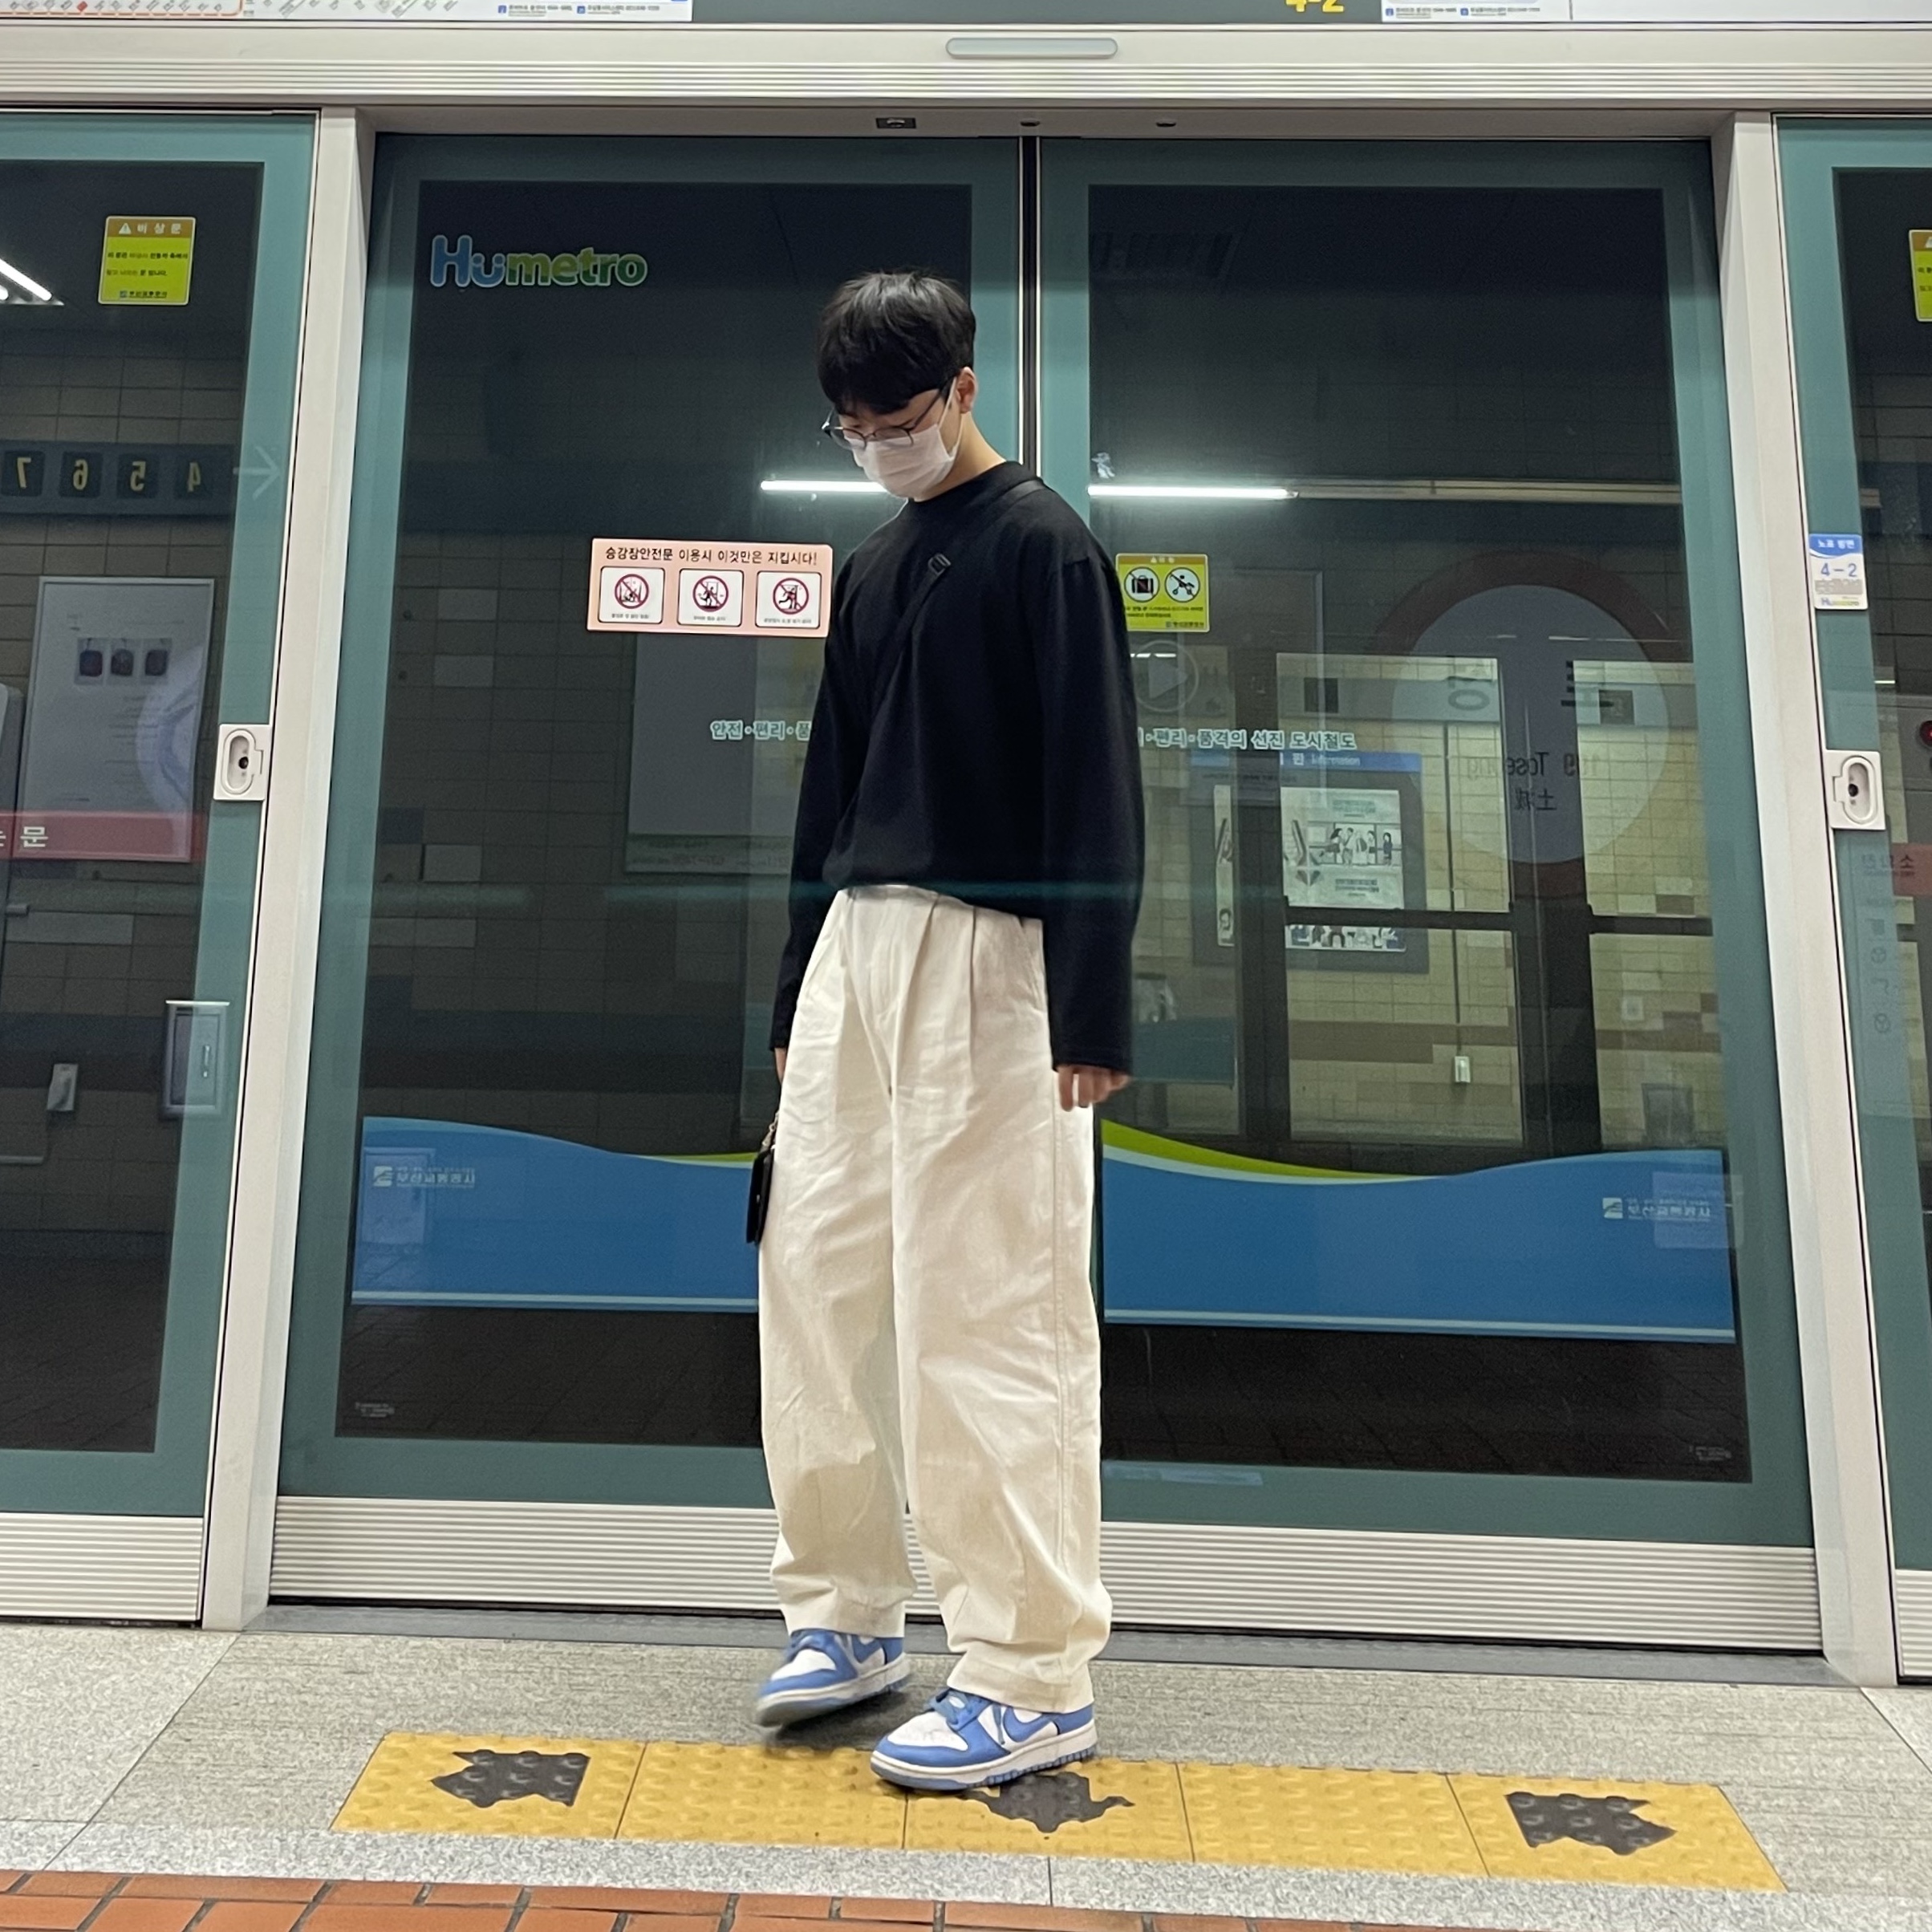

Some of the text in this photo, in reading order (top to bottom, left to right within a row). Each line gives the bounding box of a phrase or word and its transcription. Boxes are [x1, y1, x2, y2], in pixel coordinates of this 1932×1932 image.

[430, 234, 648, 287] Humetro
[605, 546, 818, 566] 승강장안전문 이용시 이것만은 지킵시다!
[1251, 729, 1285, 749] 선진
[1289, 731, 1357, 750] 도시철도
[19, 826, 49, 848] 문
